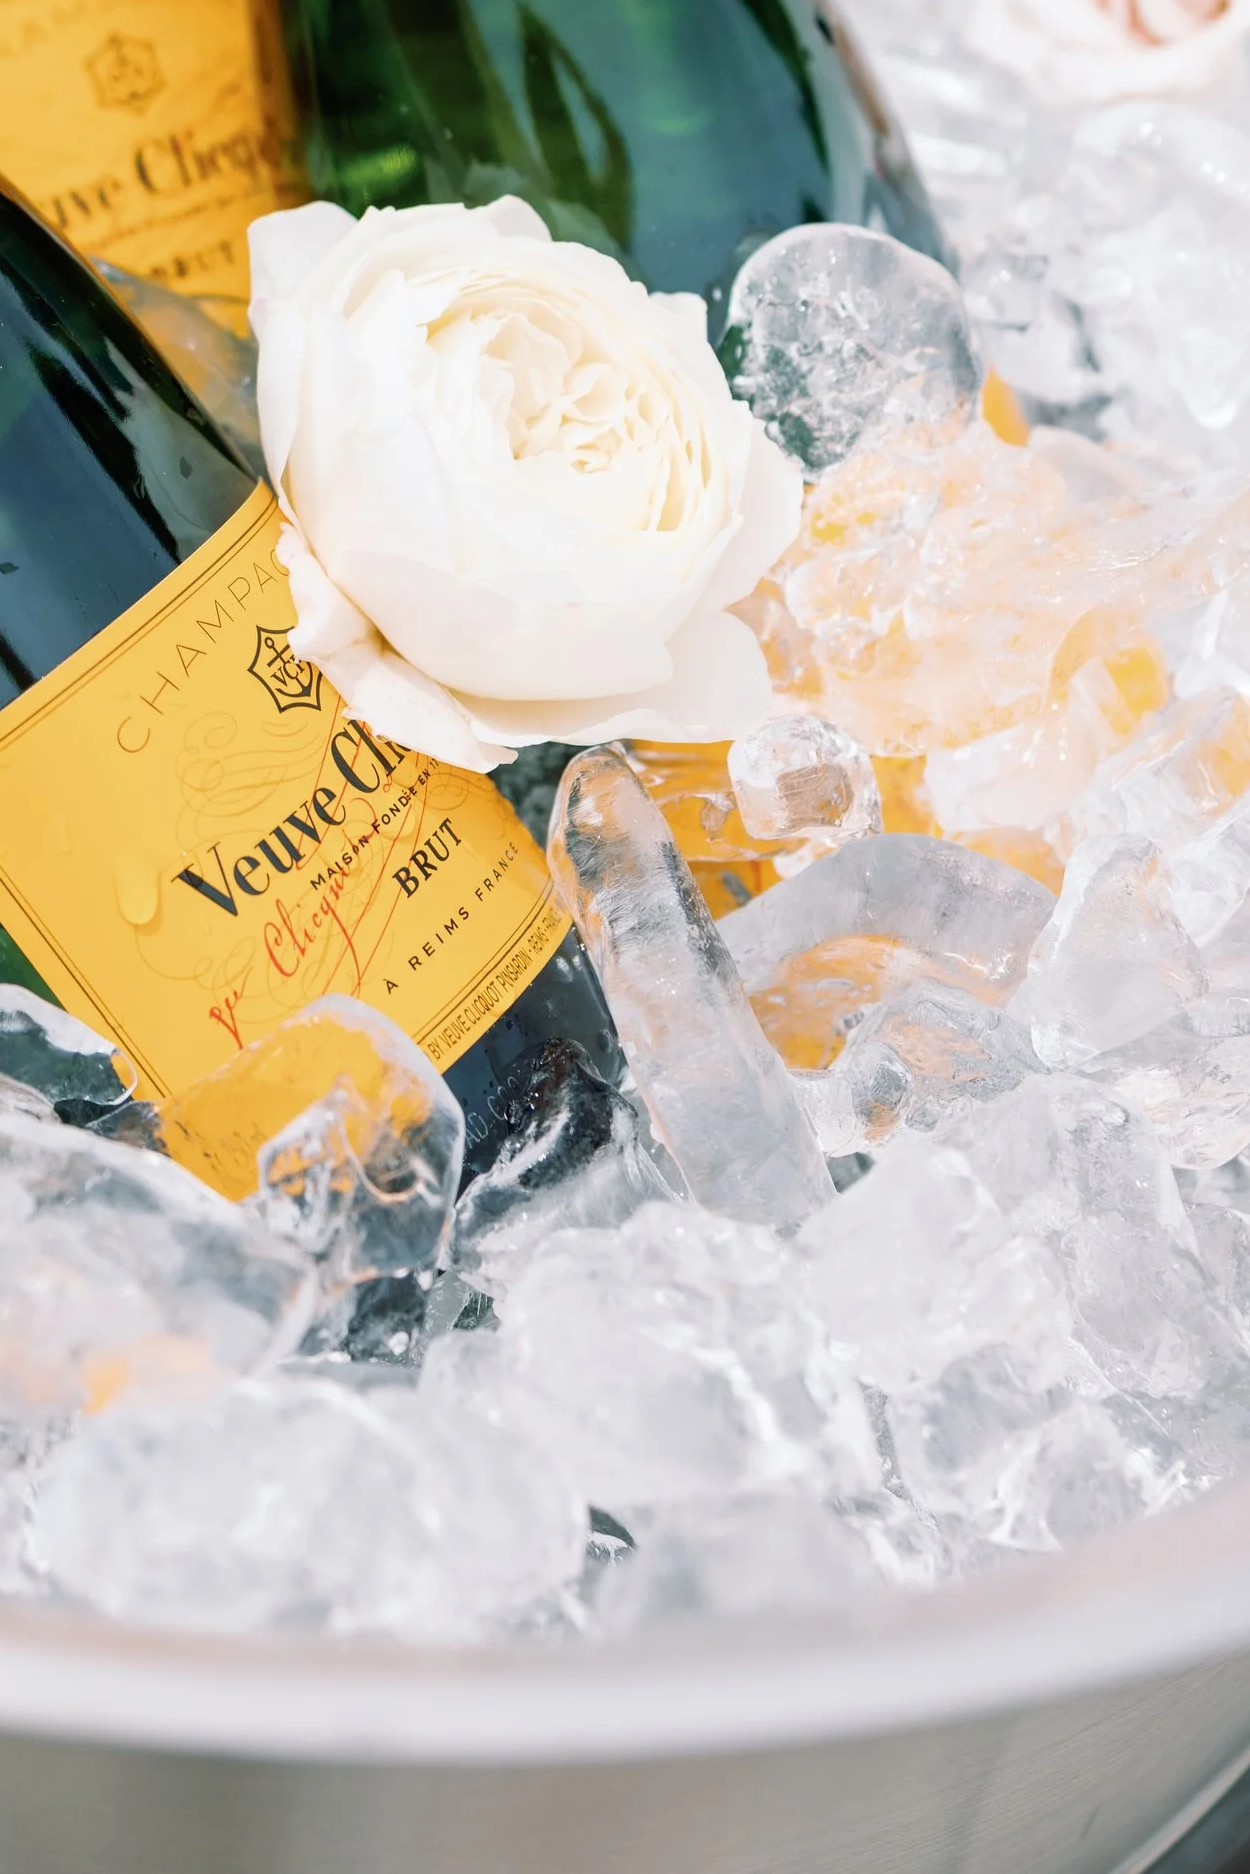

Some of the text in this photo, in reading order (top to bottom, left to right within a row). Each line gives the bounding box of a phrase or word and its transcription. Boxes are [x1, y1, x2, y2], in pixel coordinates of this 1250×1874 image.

[117, 549, 290, 753] CHAMPA
[170, 787, 347, 917] Veuve
[310, 835, 370, 890] MAISON
[417, 770, 431, 786] EN
[391, 818, 462, 899] BRUT
[408, 906, 470, 971] REIMS
[474, 842, 519, 902] FRANCE
[427, 1038, 446, 1060] BY
[439, 1014, 471, 1049] VEUVE
[464, 981, 503, 1025] CLICQUOT
